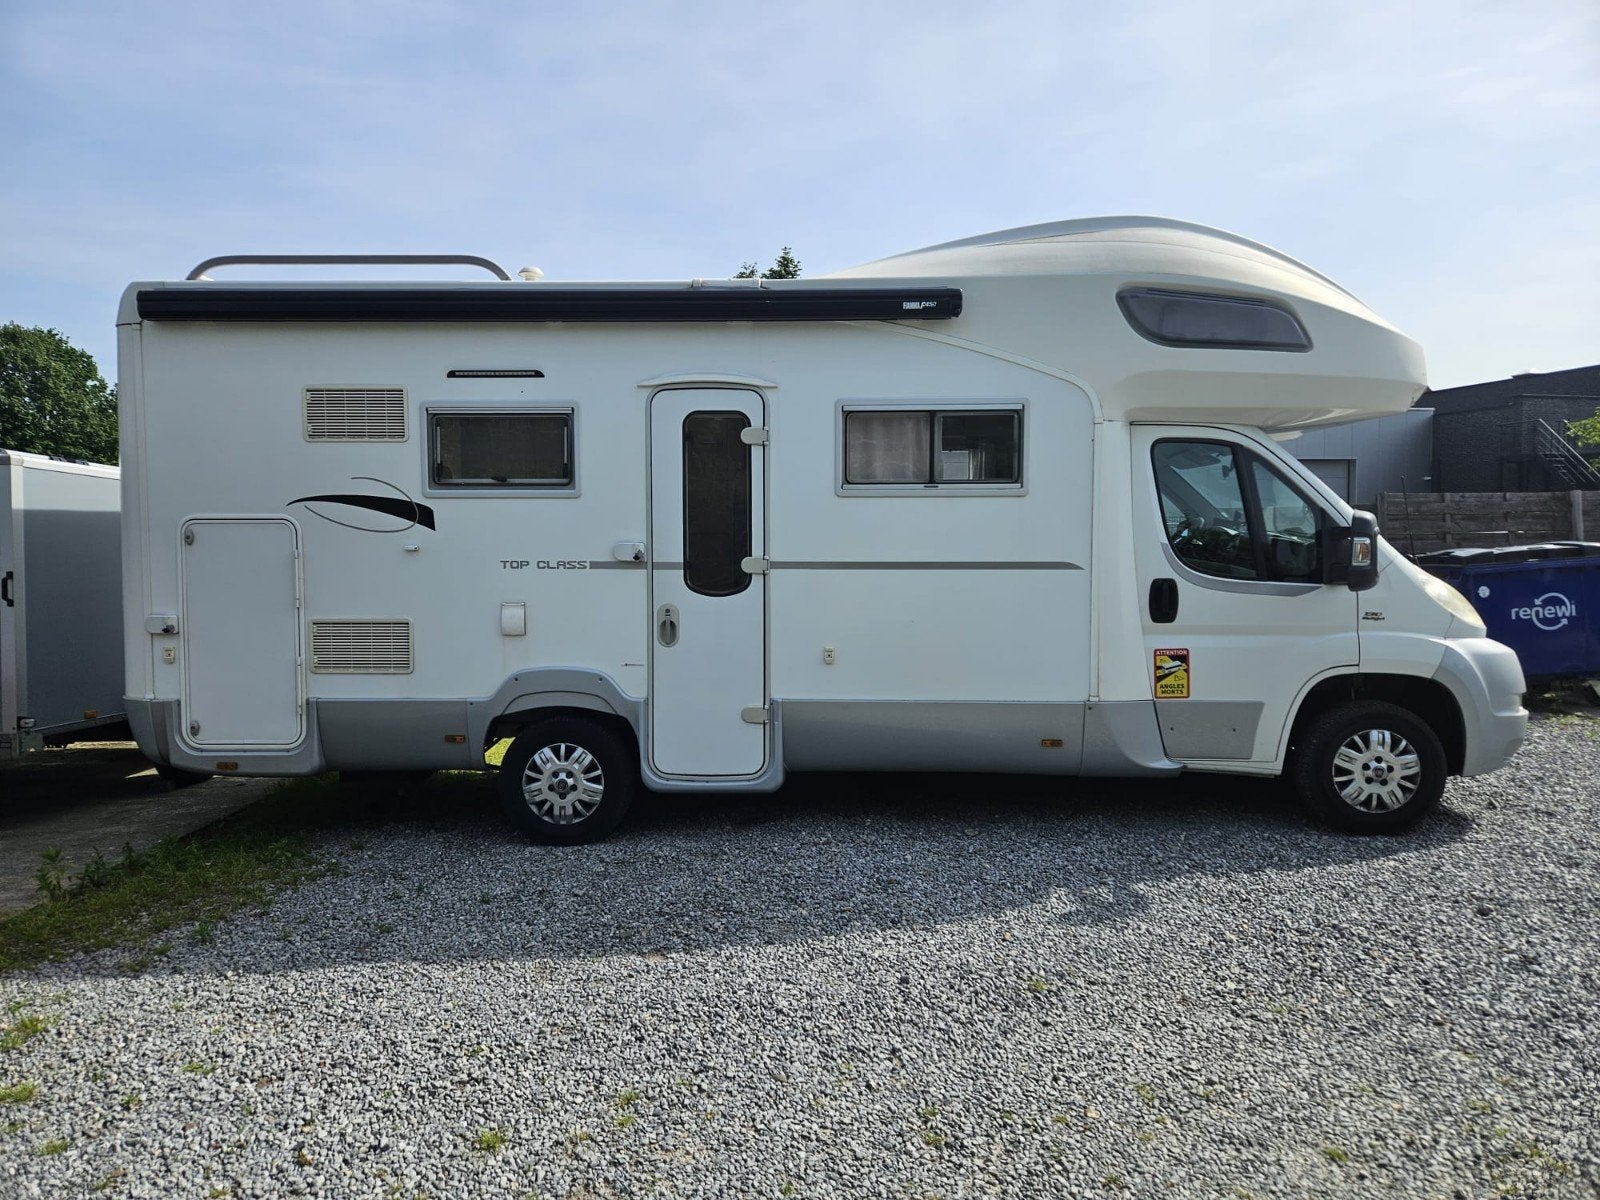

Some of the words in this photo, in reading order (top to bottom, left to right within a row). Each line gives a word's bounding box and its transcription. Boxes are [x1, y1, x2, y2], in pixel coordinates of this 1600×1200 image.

[500, 560, 530, 570] TOP
[537, 560, 588, 570] CLASS
[1511, 600, 1577, 620] renewi
